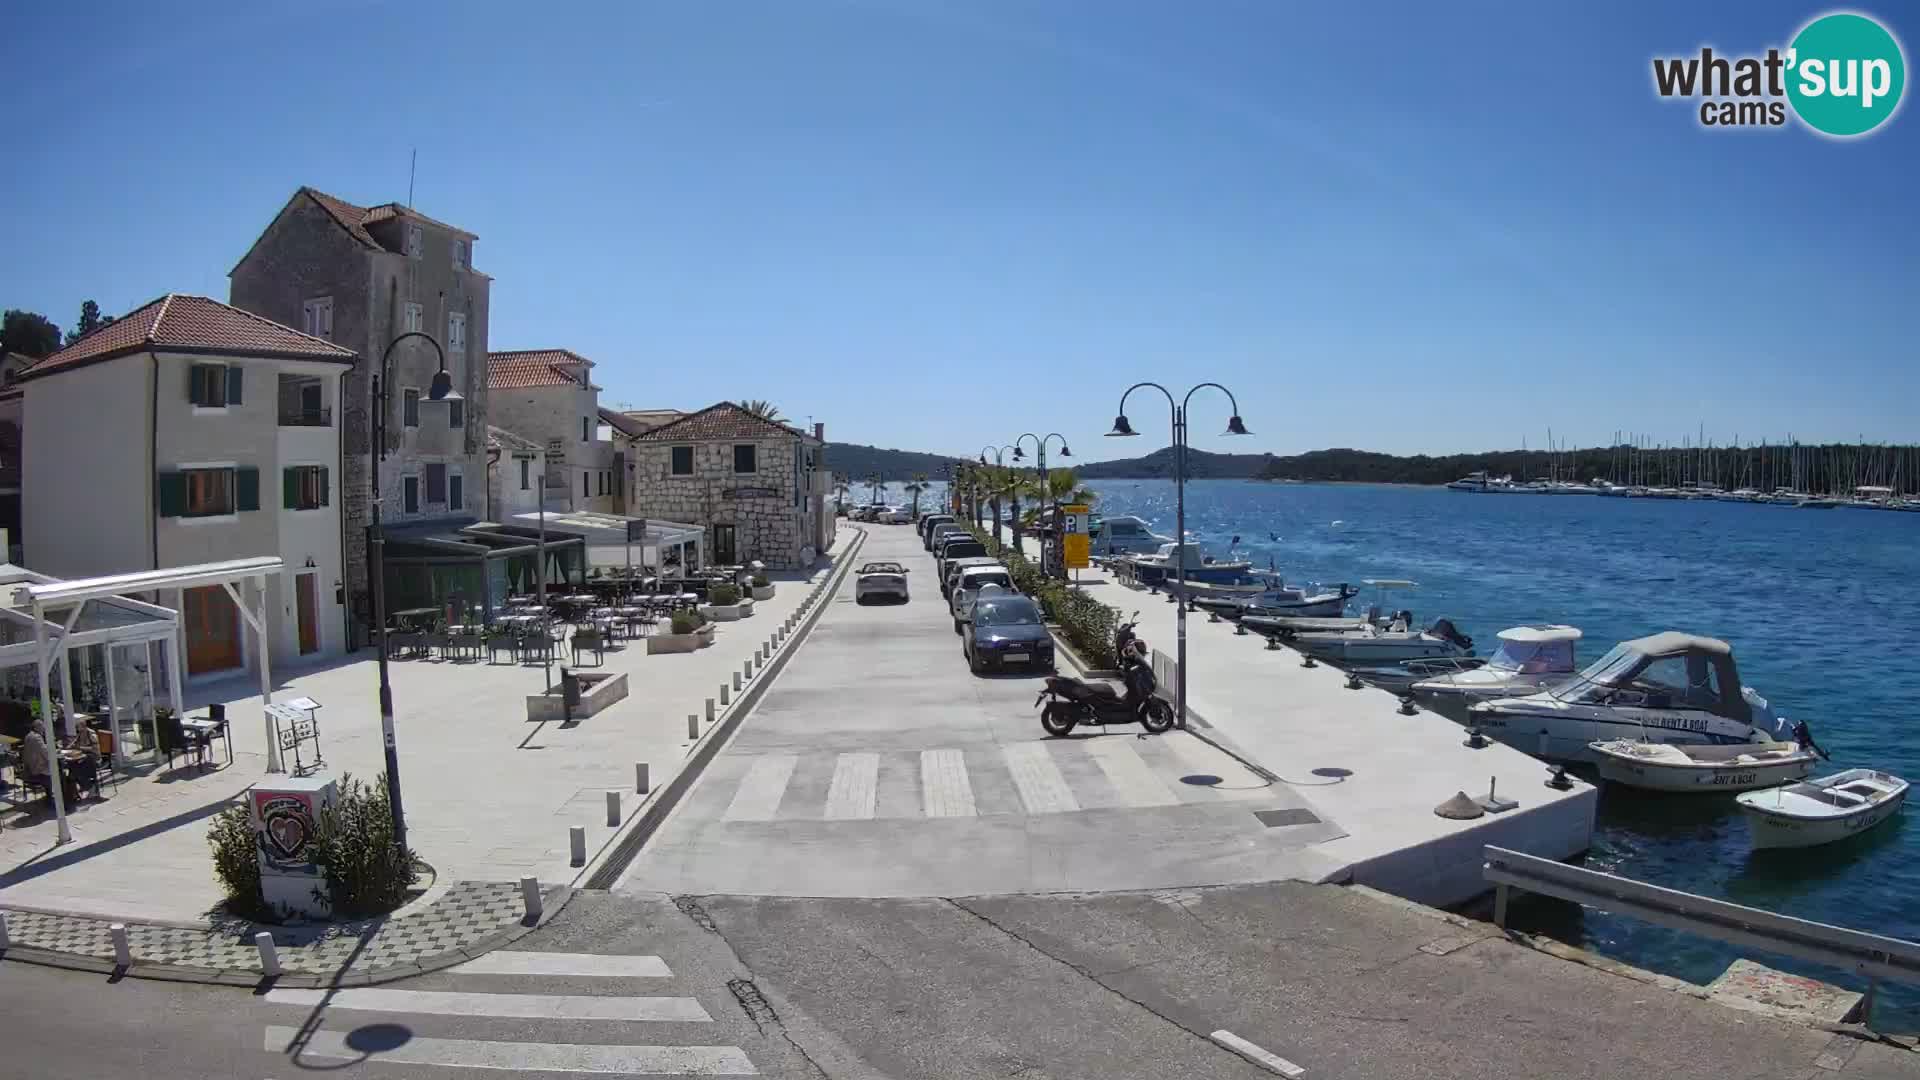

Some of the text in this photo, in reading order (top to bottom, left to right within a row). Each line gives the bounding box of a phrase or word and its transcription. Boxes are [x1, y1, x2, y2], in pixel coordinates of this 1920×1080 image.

[1661, 718, 1681, 729] RENT
[1690, 719, 1708, 732] BOAT
[1738, 773, 1757, 785] BOAT
